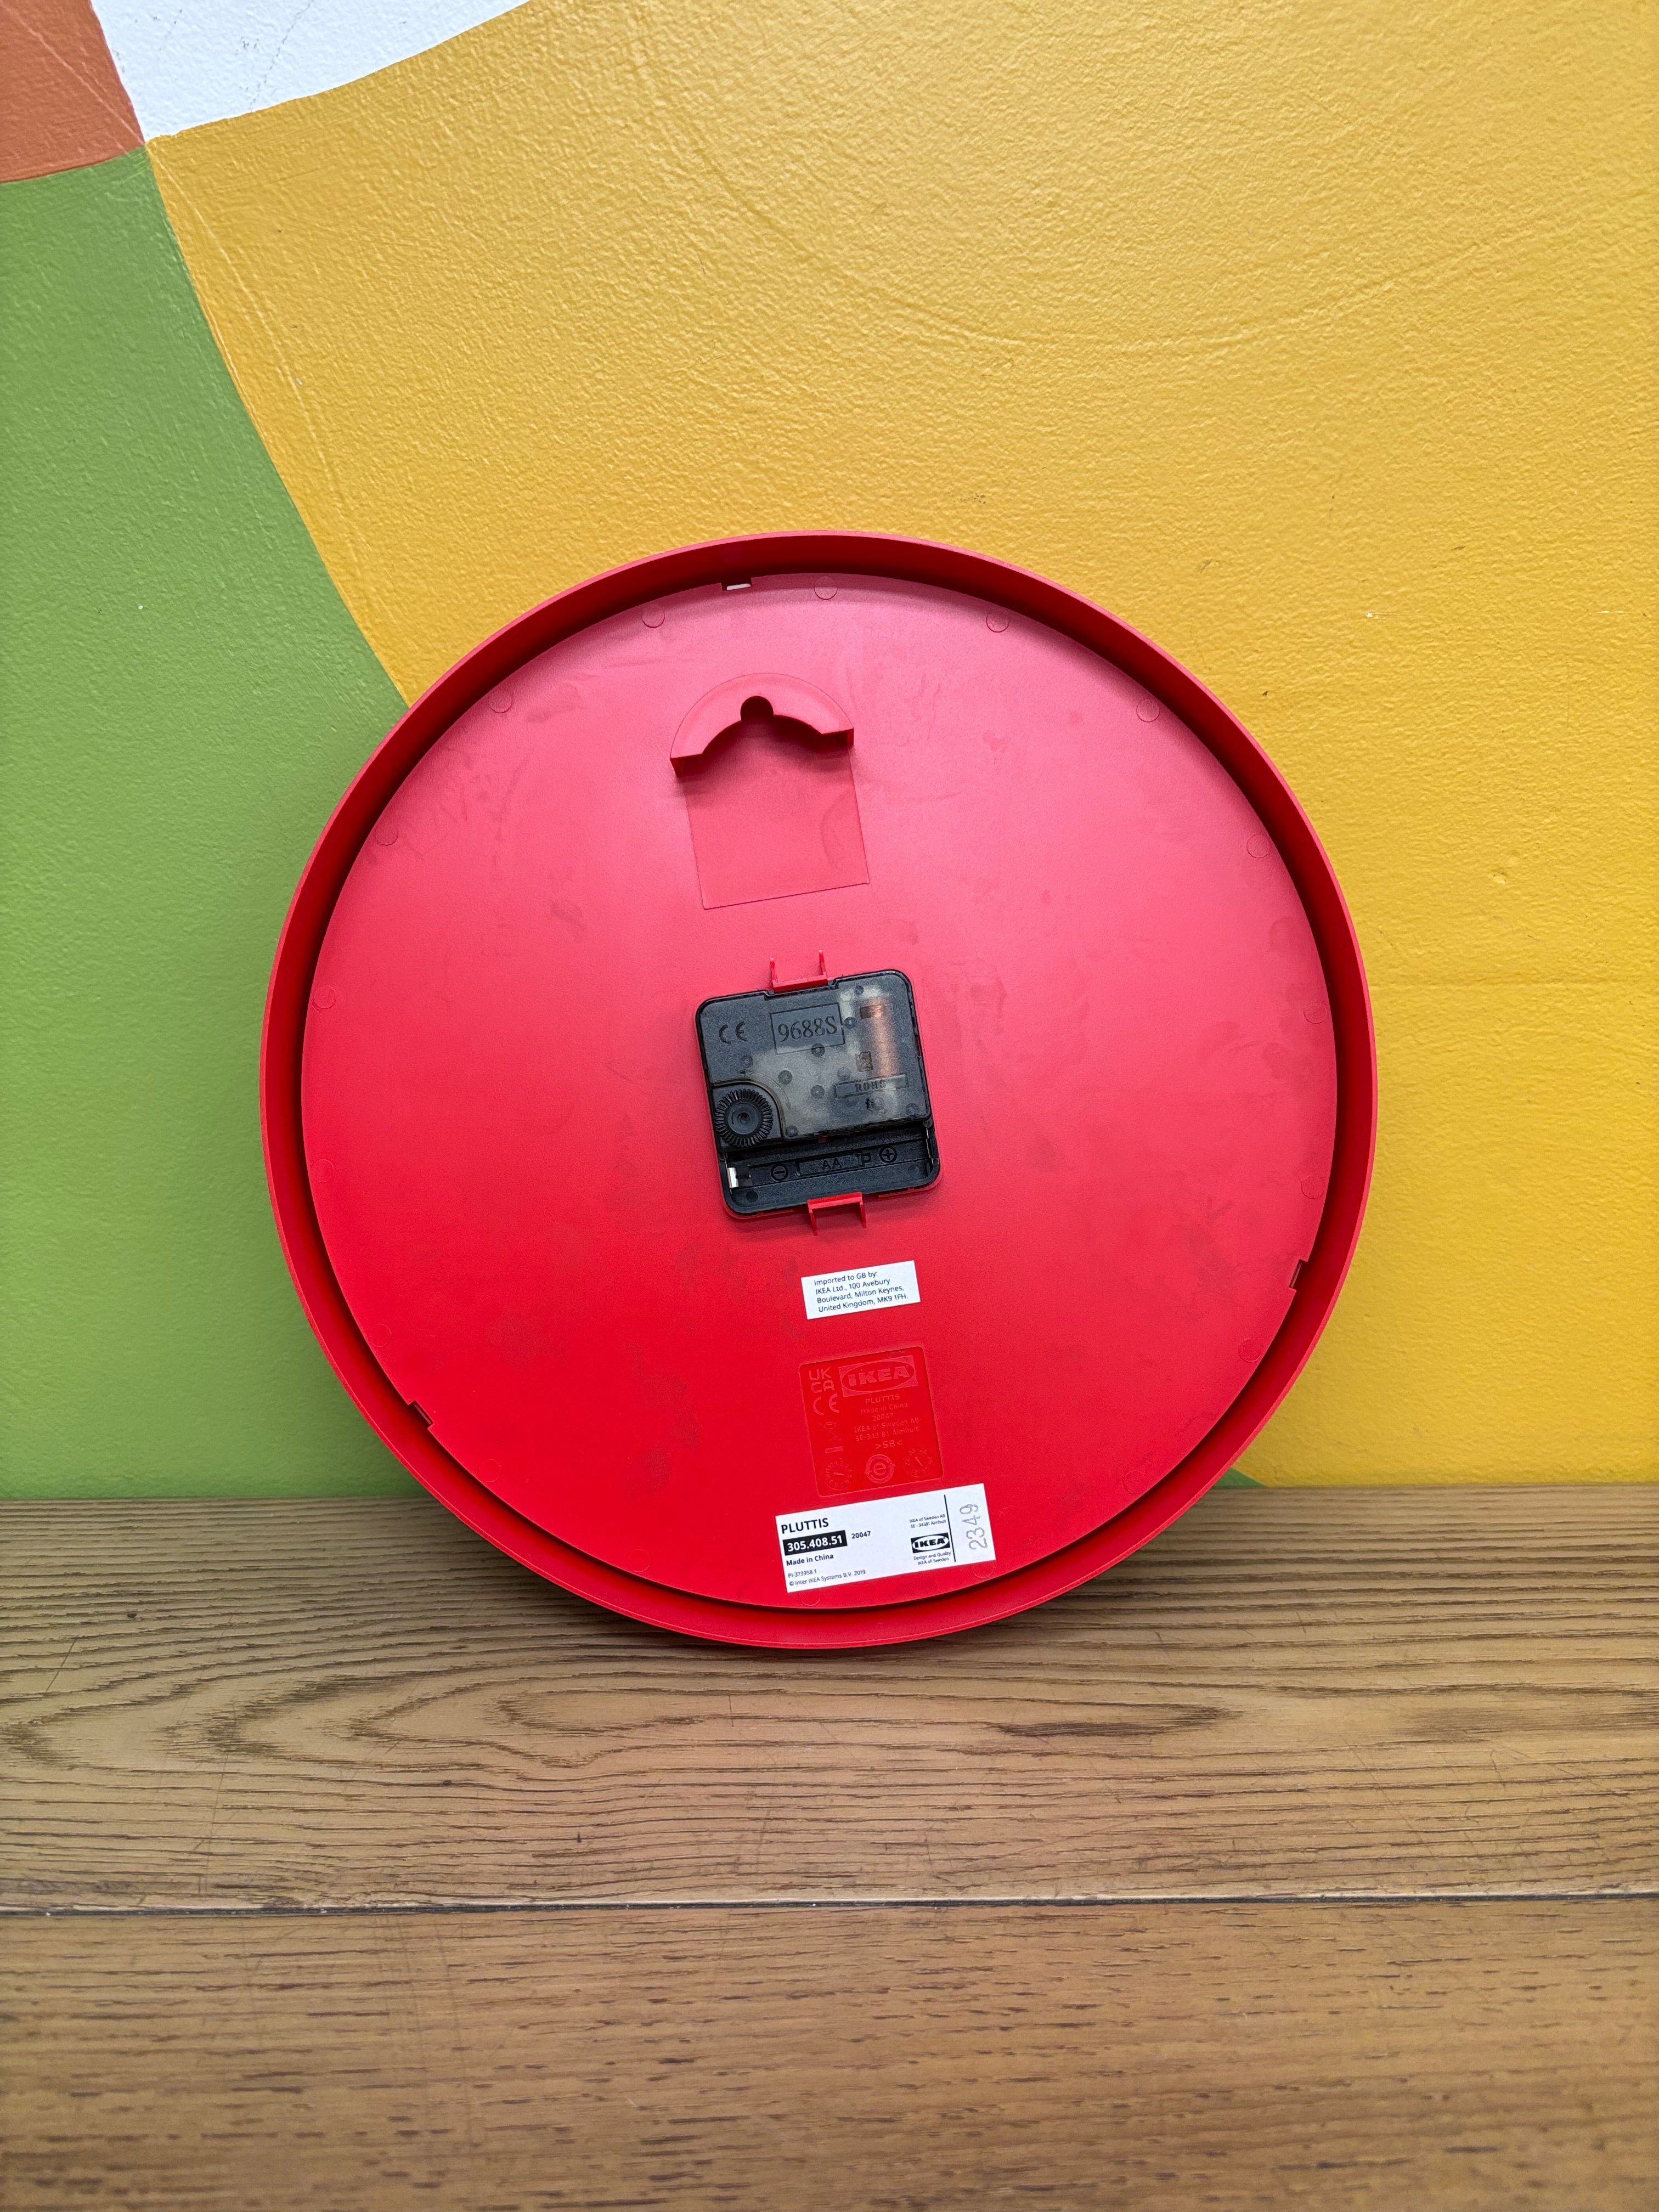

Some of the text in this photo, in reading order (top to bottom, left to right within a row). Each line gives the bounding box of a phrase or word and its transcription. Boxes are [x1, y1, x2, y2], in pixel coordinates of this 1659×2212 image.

[777, 1015, 838, 1042] 9688S
[823, 1158, 842, 1172] AA
[814, 1275, 846, 1286] Imported
[815, 1286, 831, 1295] IKEA
[862, 1279, 890, 1287] Avebury
[817, 1293, 853, 1304] Boulevard,
[819, 1303, 841, 1312] United
[843, 1300, 875, 1308] Kingdom,
[808, 1367, 832, 1381] UK
[847, 1365, 911, 1387] IKEA
[865, 1393, 900, 1404] PLUTTIS
[872, 1413, 893, 1421] 20047
[781, 1517, 829, 1534] PLUTTIS
[959, 1504, 988, 1550] 2349
[787, 1531, 871, 1552] 305.408.51 20047
[914, 1538, 945, 1548] IKEA
[786, 1558, 805, 1566] Made
[822, 1574, 842, 1582] Systems
